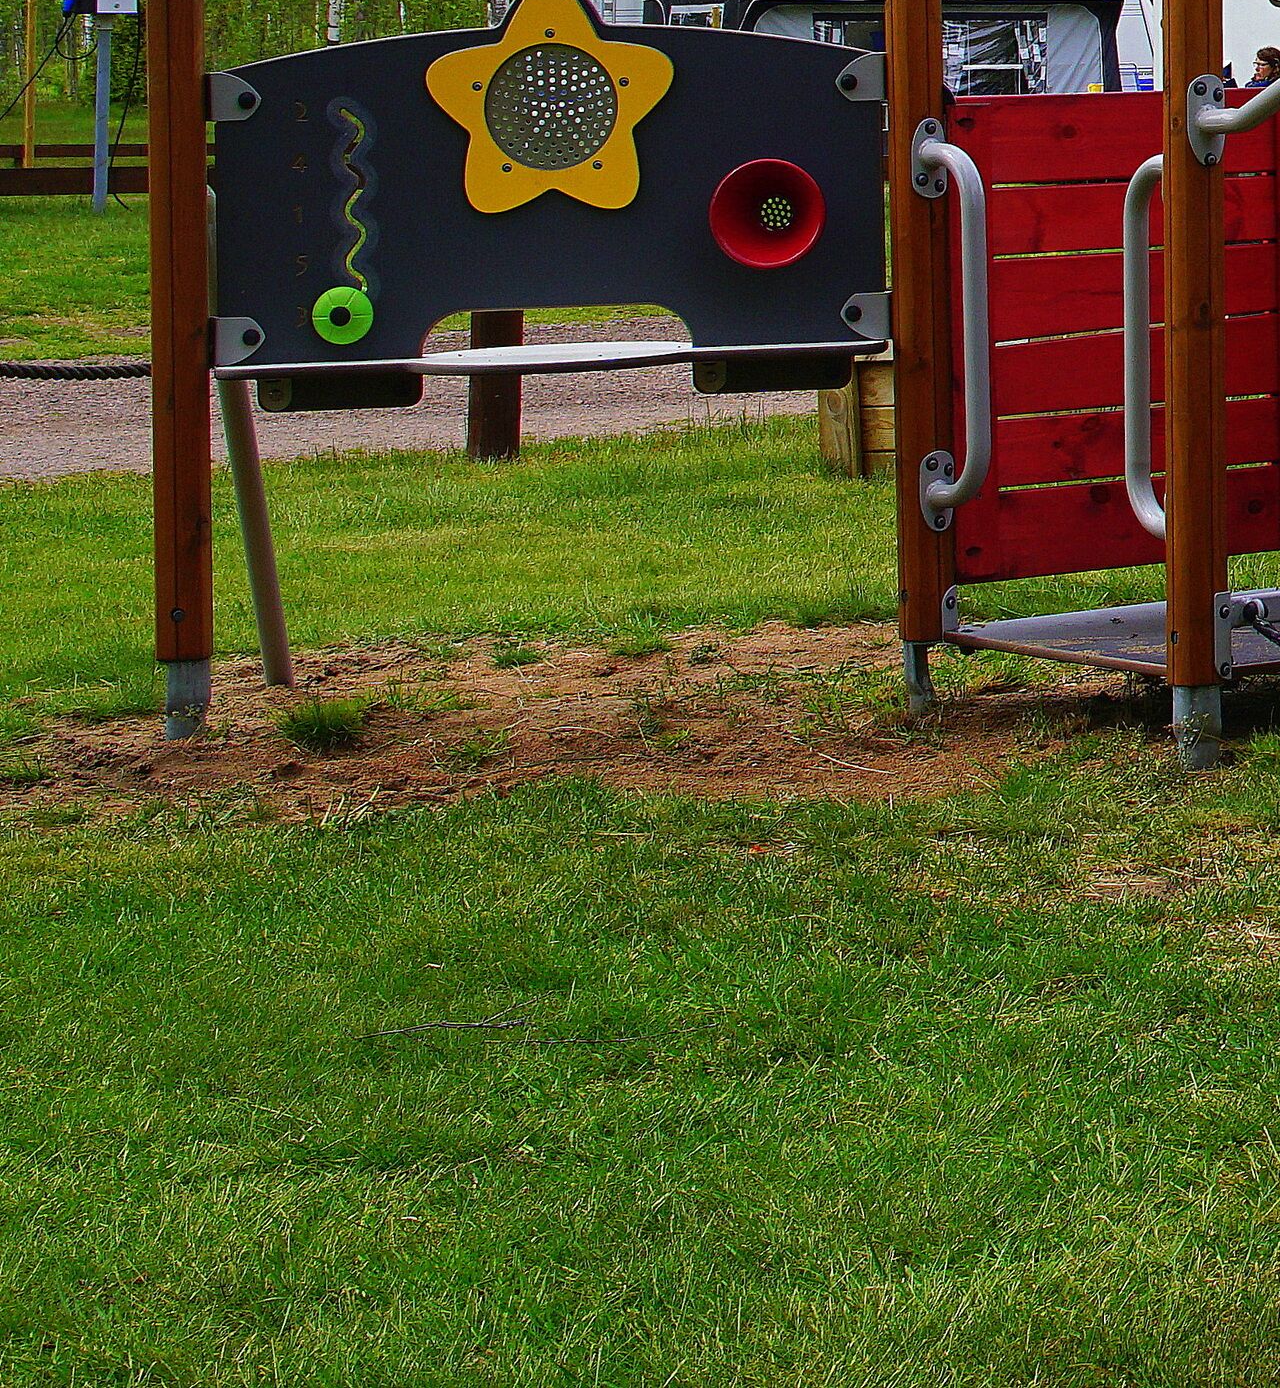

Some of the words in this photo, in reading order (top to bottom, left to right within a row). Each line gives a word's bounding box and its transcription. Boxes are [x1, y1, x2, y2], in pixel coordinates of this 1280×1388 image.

[295, 101, 309, 122] 2
[292, 154, 308, 173] 4
[293, 203, 303, 223] 1
[295, 255, 308, 277] 5
